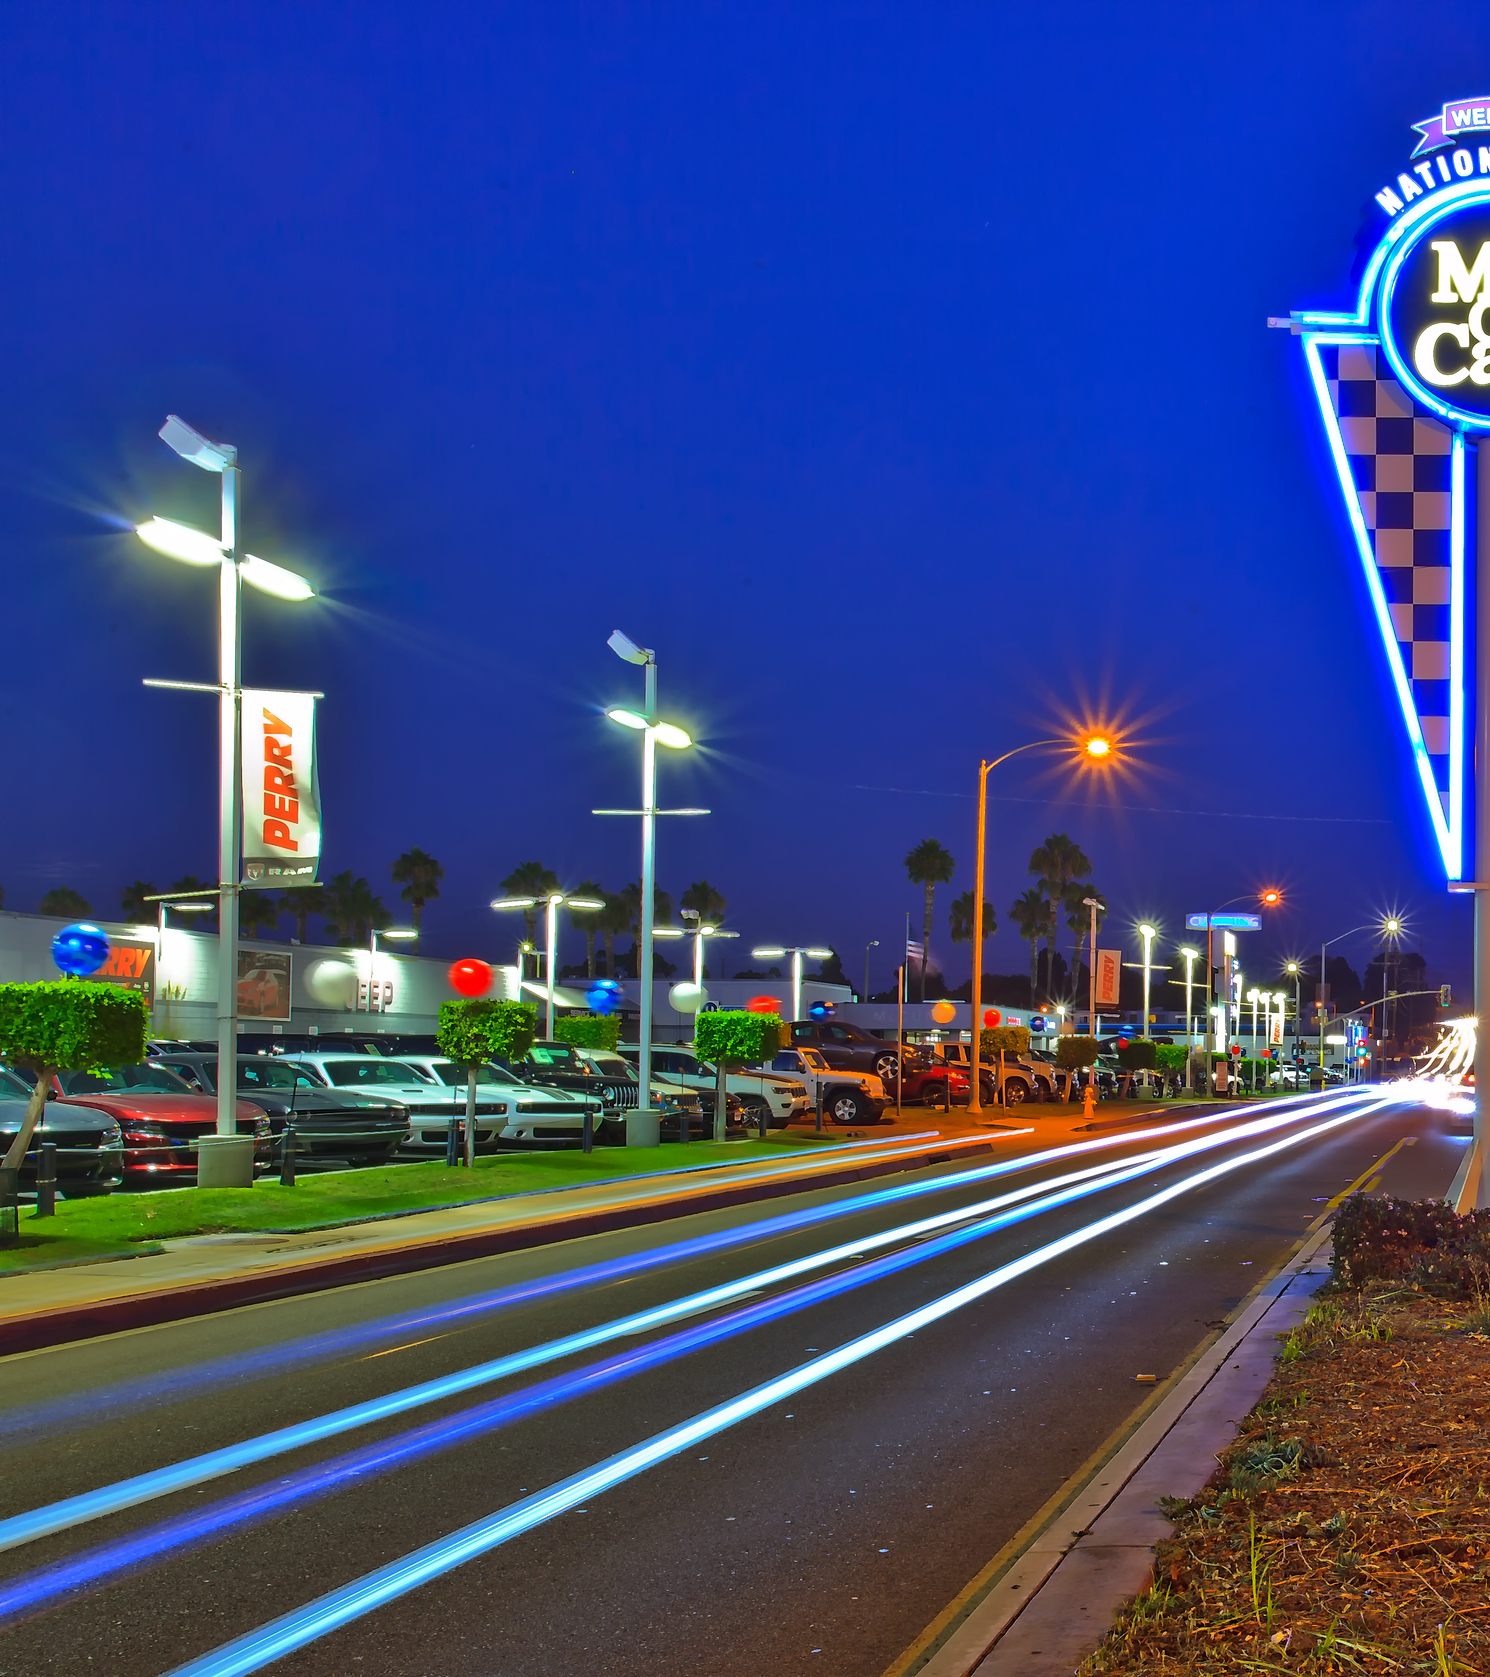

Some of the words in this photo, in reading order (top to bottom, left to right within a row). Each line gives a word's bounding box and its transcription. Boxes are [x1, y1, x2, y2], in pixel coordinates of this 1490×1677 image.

[263, 707, 299, 852] PERRY
[268, 866, 313, 876] RAM
[95, 946, 152, 978] RRY
[1102, 954, 1115, 1002] PERRY
